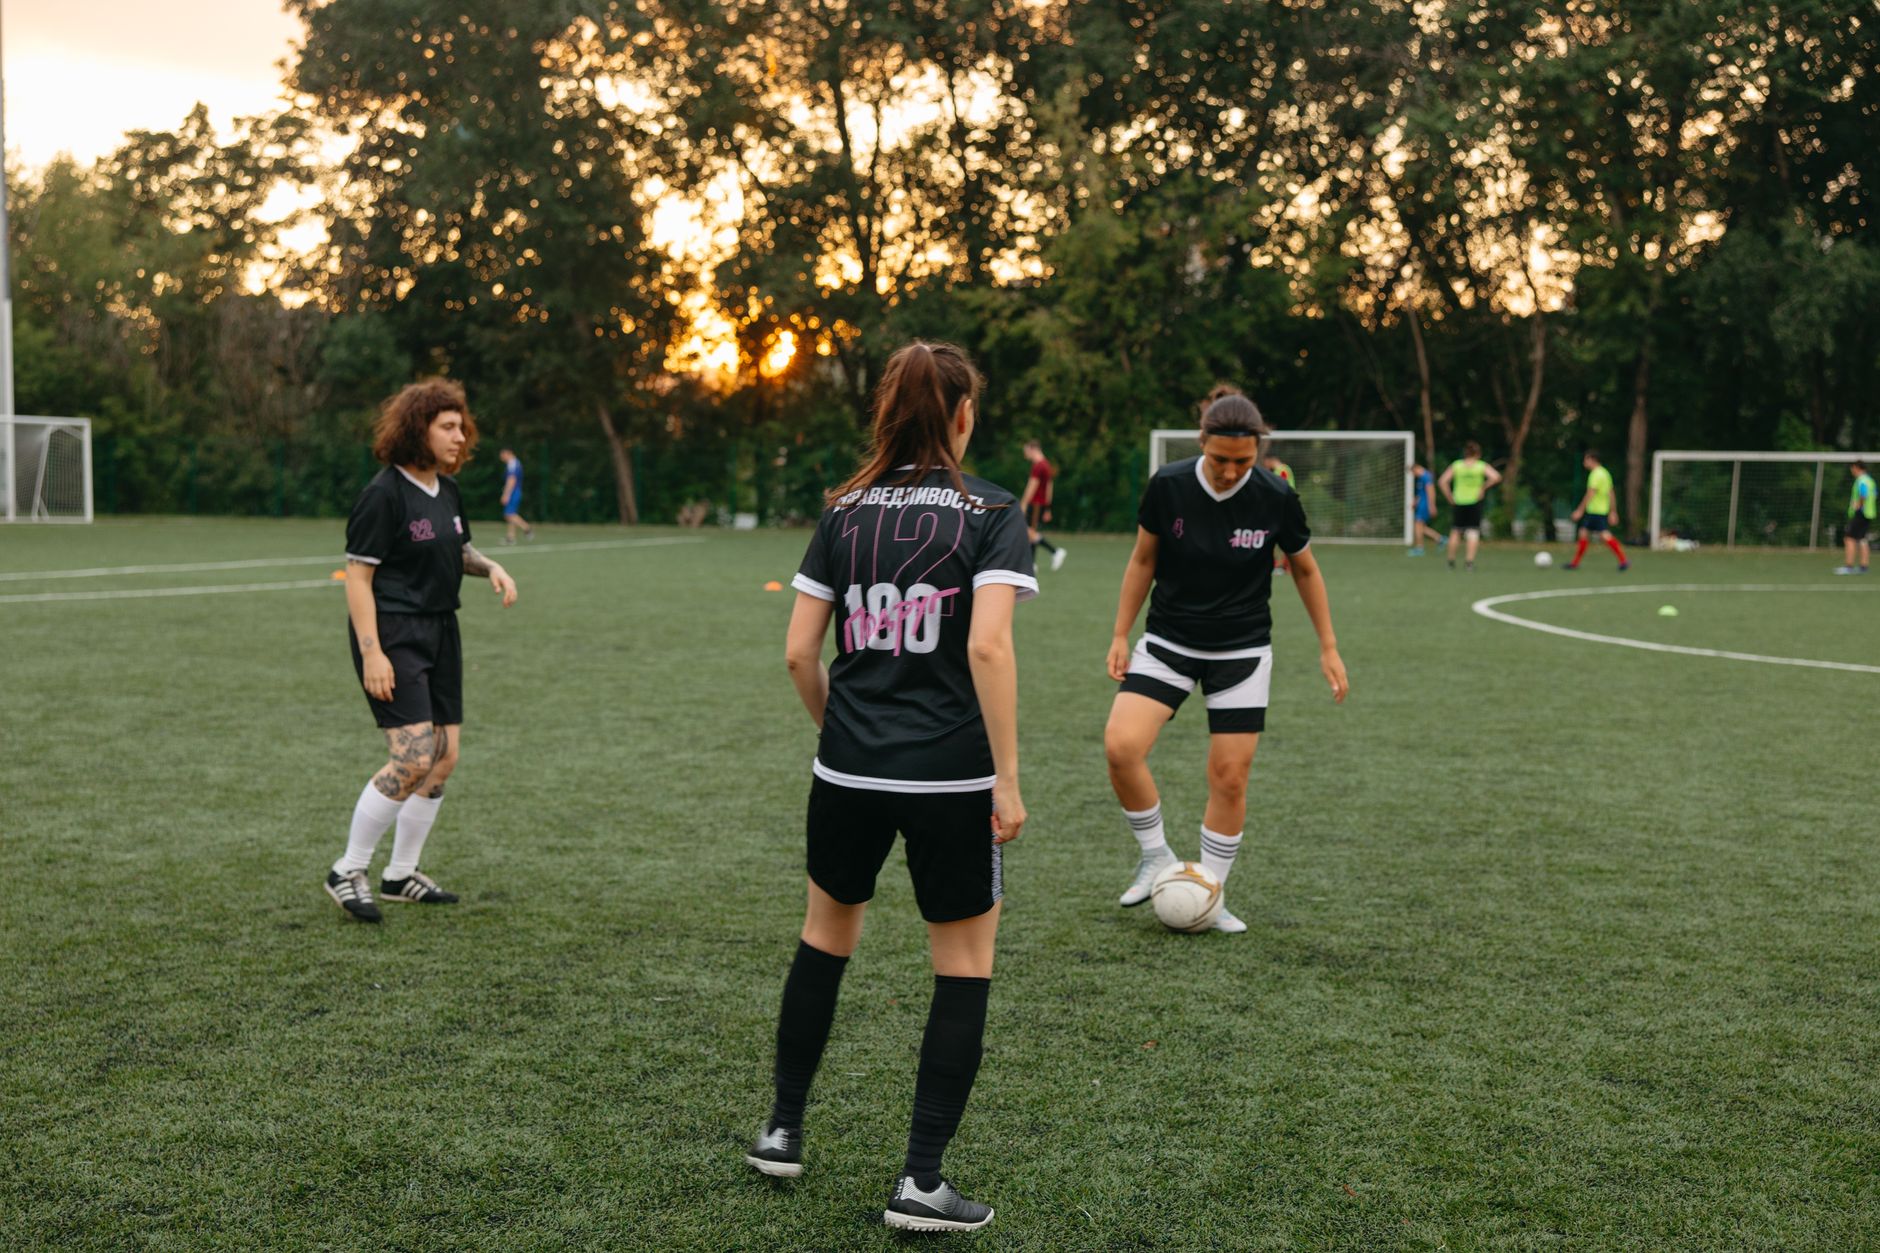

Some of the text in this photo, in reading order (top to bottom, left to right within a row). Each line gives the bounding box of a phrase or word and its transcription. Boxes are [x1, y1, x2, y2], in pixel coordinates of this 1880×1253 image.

[833, 486, 988, 515] РАВЕДЛИВОСТЬ
[842, 499, 965, 617] 12
[1233, 528, 1266, 549] 100
[844, 582, 942, 654] 100
